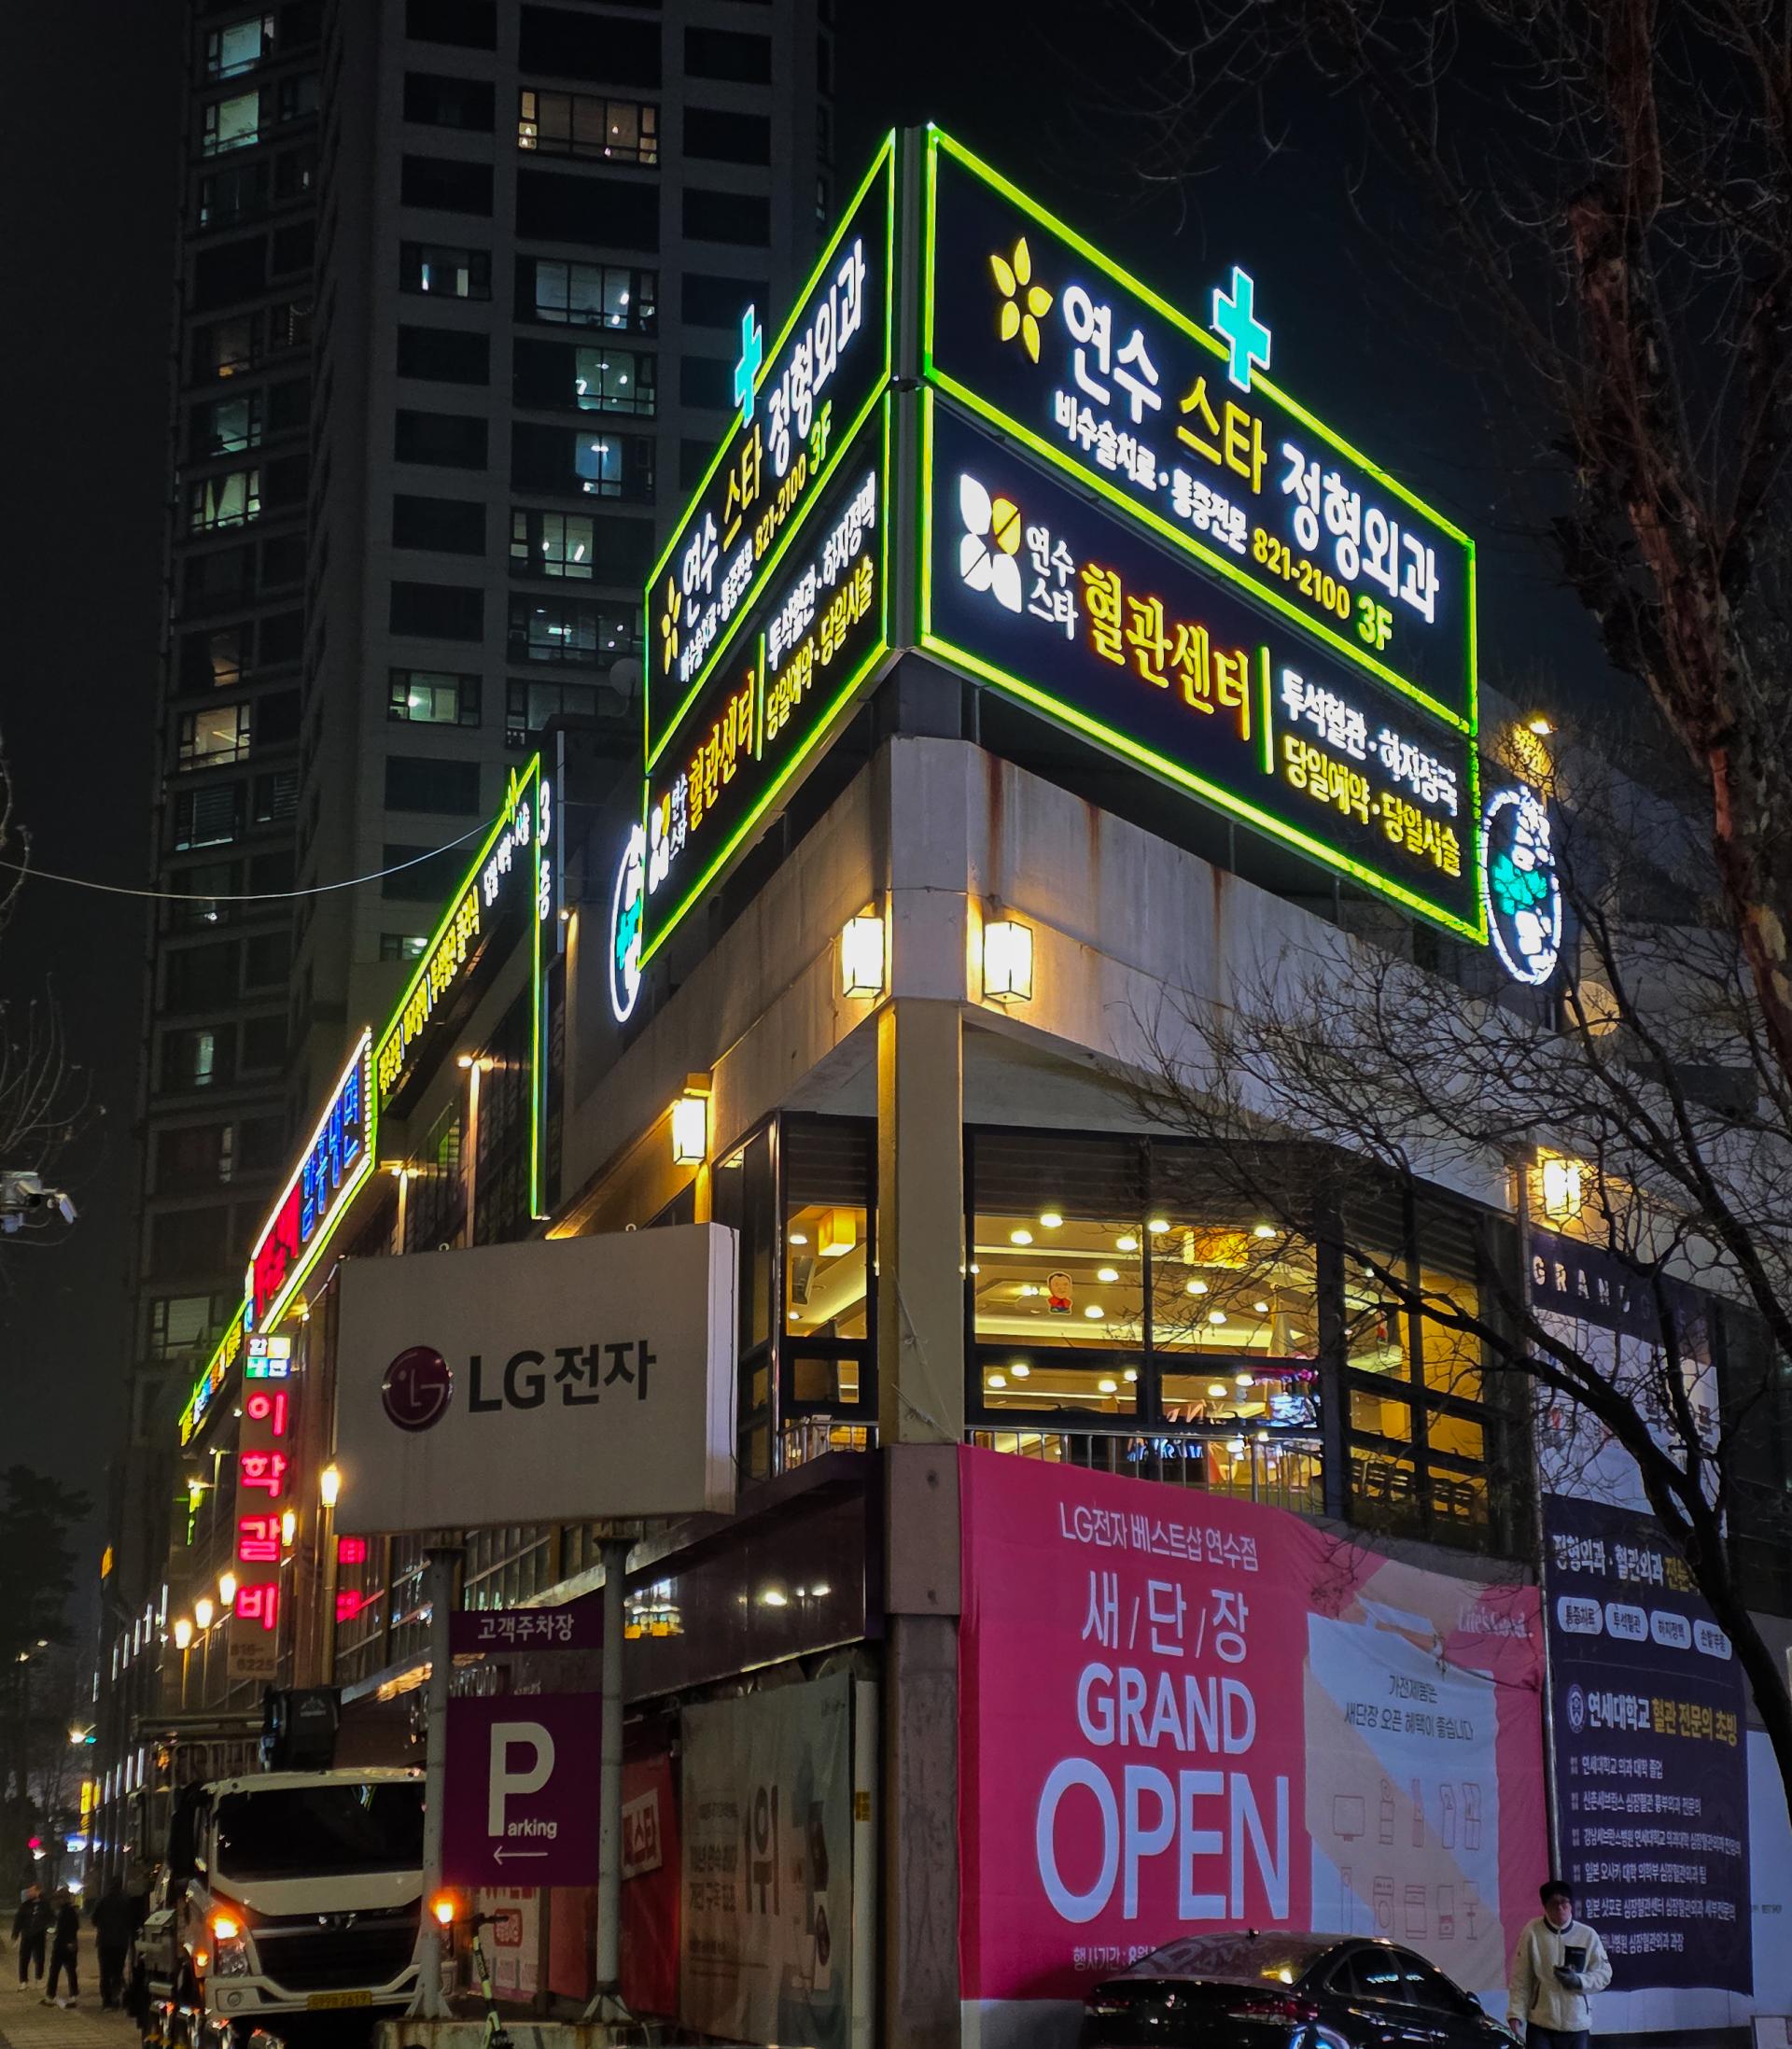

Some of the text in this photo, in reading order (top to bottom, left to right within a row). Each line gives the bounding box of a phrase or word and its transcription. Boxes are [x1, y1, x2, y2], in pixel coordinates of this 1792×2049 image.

[683, 238, 865, 627] 연수 스타 정형외과
[1062, 286, 1439, 623] 연수 스타 정형외과
[755, 454, 805, 560] 821-2100
[810, 400, 832, 475] 3F
[1026, 526, 1075, 582] 연수
[1253, 527, 1351, 617] 821-2100
[1357, 596, 1393, 650] 3F
[1028, 582, 1078, 640] 스타
[1082, 563, 1251, 741] 혈관센터
[689, 670, 754, 831] 혈관센터
[469, 1340, 657, 1413] LG전자
[234, 1390, 288, 1632] 이학갈비
[1059, 1502, 1259, 1572] LG전자 베스트샵 연수점
[1664, 1556, 1701, 1595] 전문
[478, 1614, 575, 1643] 고객주차장
[1077, 1662, 1257, 1755] GRAND
[1344, 1703, 1379, 1728] 새단장
[1381, 1708, 1402, 1733] 오픈
[1436, 1717, 1474, 1740] 좋습니다
[1389, 1675, 1438, 1704] 가전제품은
[1588, 1691, 1738, 1747] 연세대학교 혈관 전문의 초빙
[1036, 1758, 1289, 1923] OPEN
